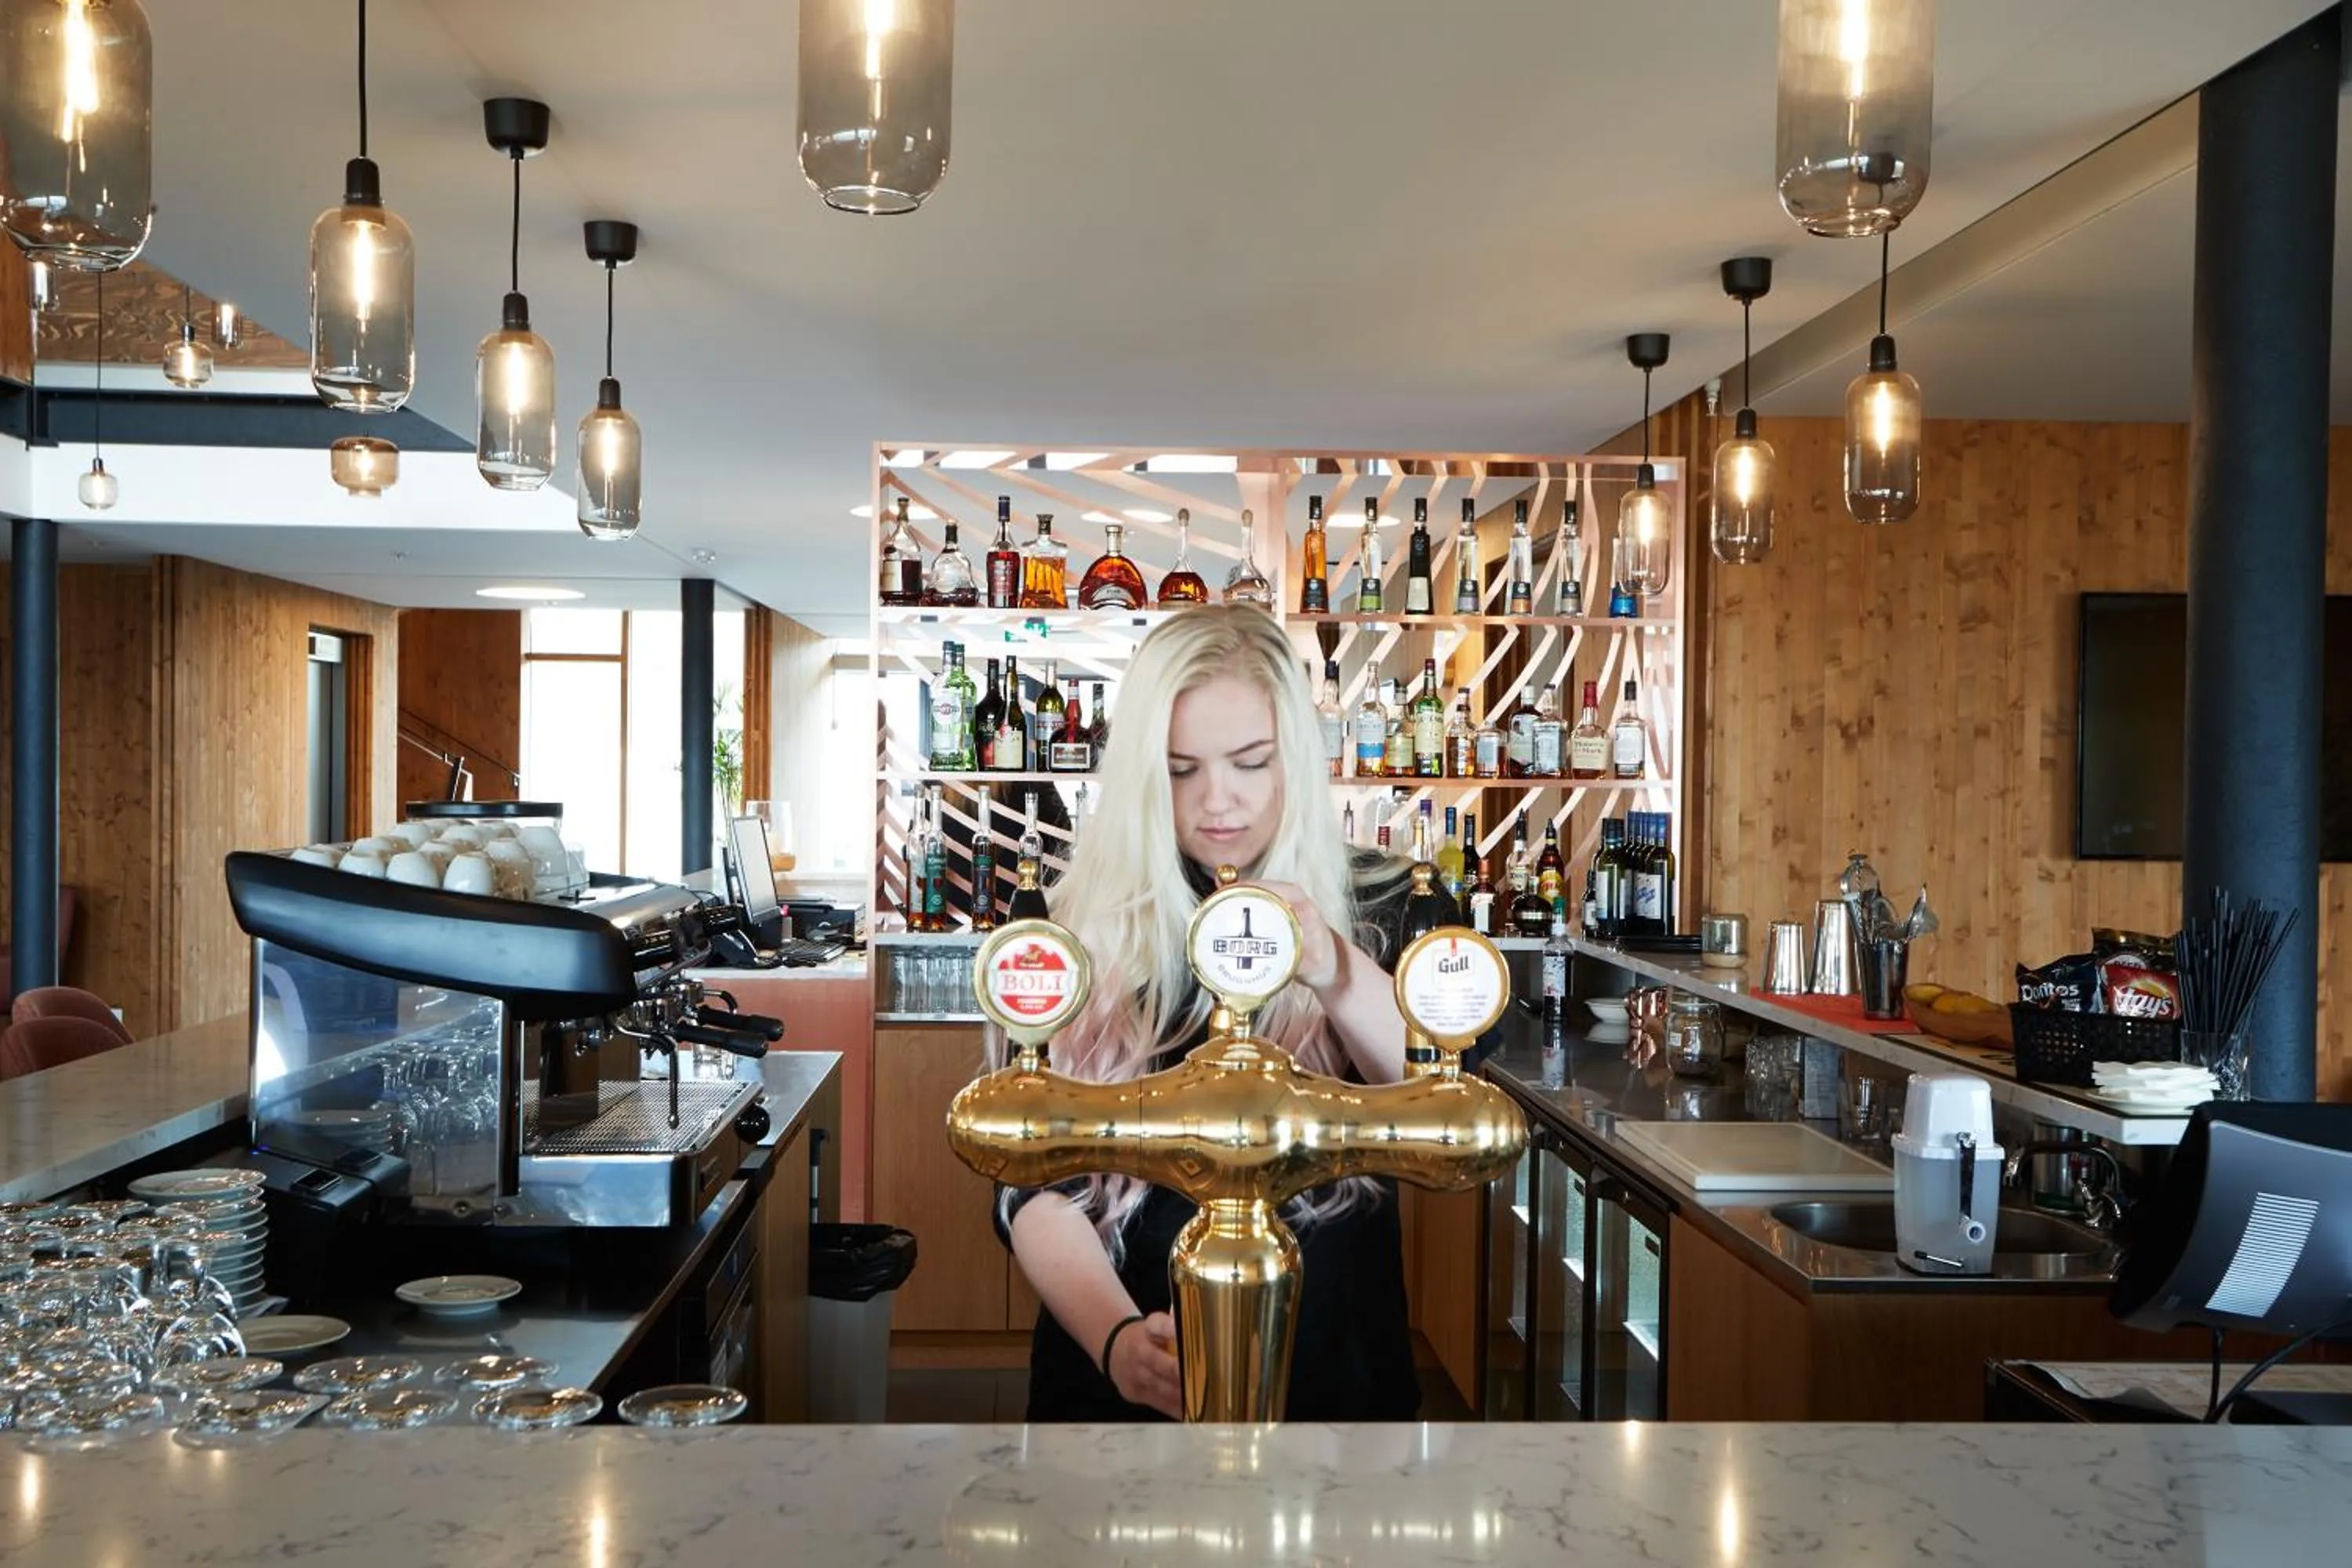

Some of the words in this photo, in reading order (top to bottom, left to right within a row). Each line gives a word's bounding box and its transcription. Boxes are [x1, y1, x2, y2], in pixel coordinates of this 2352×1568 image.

[1213, 939, 1277, 955] BORG
[1438, 956, 1469, 974] Gull
[1003, 974, 1063, 991] BOLI
[2020, 982, 2080, 1002] Doritos
